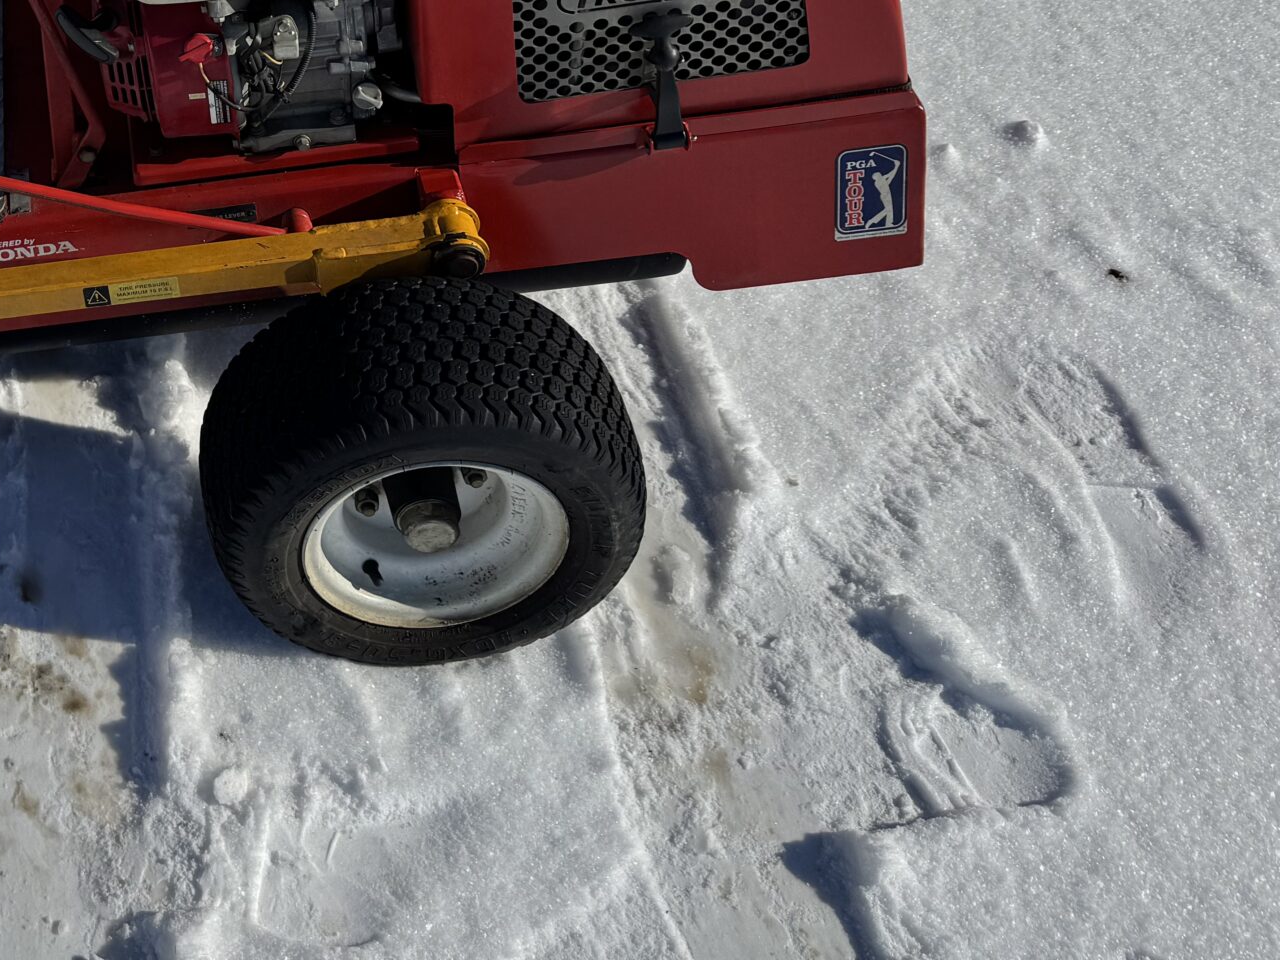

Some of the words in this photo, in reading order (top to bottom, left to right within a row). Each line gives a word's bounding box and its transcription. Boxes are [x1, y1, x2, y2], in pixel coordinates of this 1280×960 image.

[846, 159, 877, 171] PGA
[845, 170, 865, 227] TOUR
[24, 238, 35, 246] by
[135, 281, 170, 290] PRESSURE
[117, 289, 148, 297] MAXIMUM
